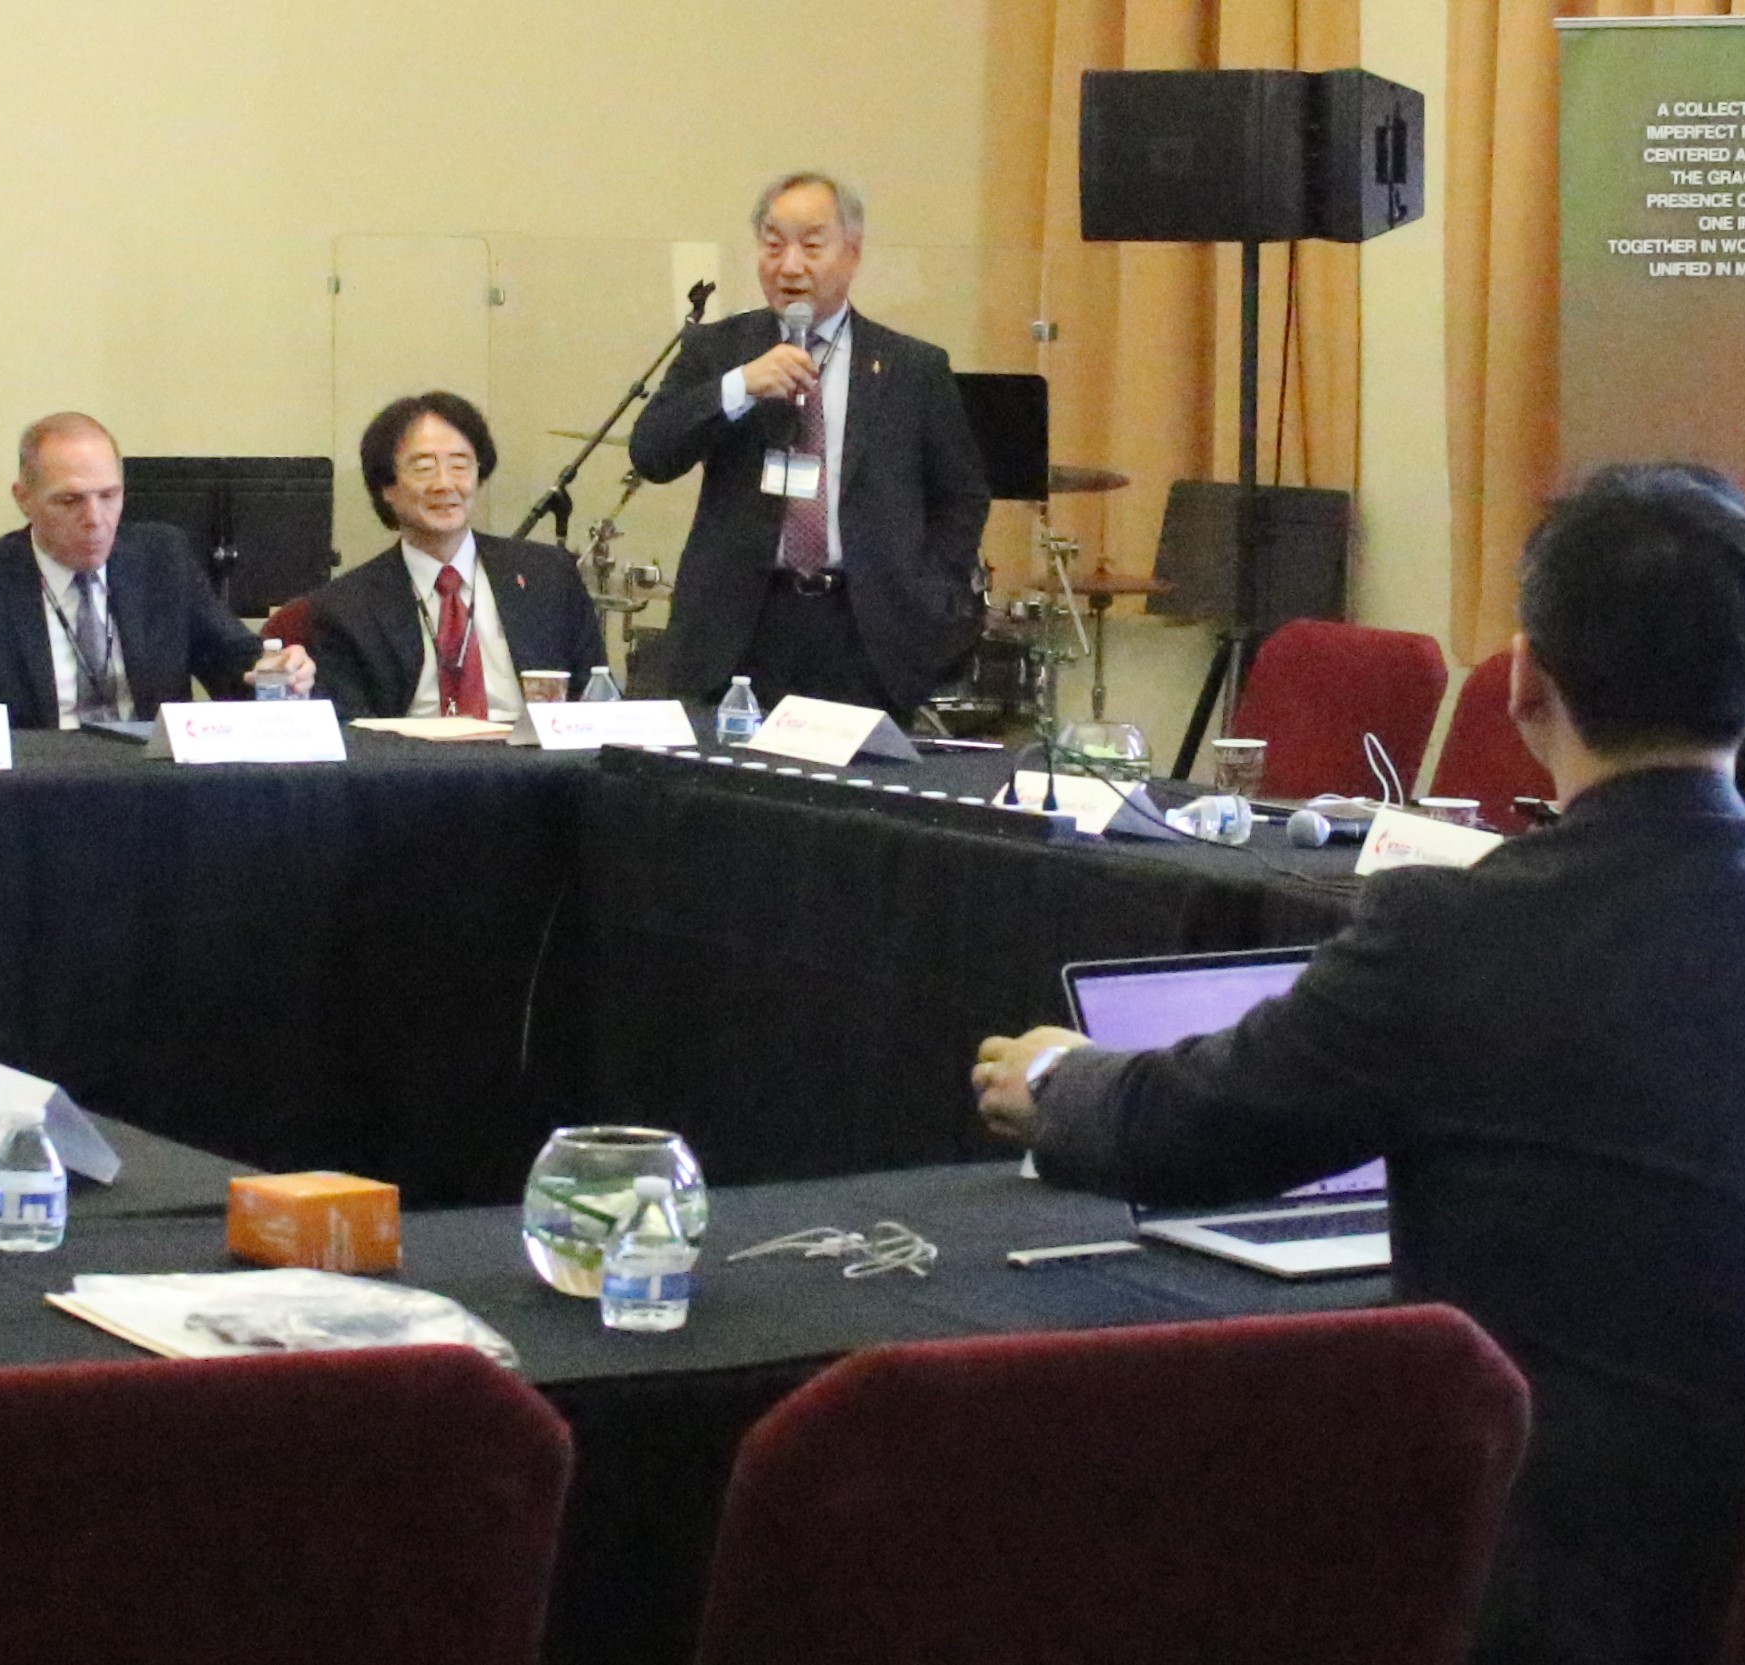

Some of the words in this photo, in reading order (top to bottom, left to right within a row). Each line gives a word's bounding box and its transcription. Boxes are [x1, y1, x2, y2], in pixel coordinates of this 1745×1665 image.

[1657, 102, 1669, 117] A
[1646, 125, 1737, 139] IMPERFECT
[1643, 148, 1730, 163] CENTERED
[1670, 171, 1703, 185] THE
[1646, 193, 1732, 208] PRESENCE
[1698, 216, 1733, 230] ONE
[1607, 239, 1696, 254] TOGETHER
[1700, 239, 1716, 253] IN
[1649, 262, 1711, 276] UNIFIED
[1715, 262, 1731, 276] IN
